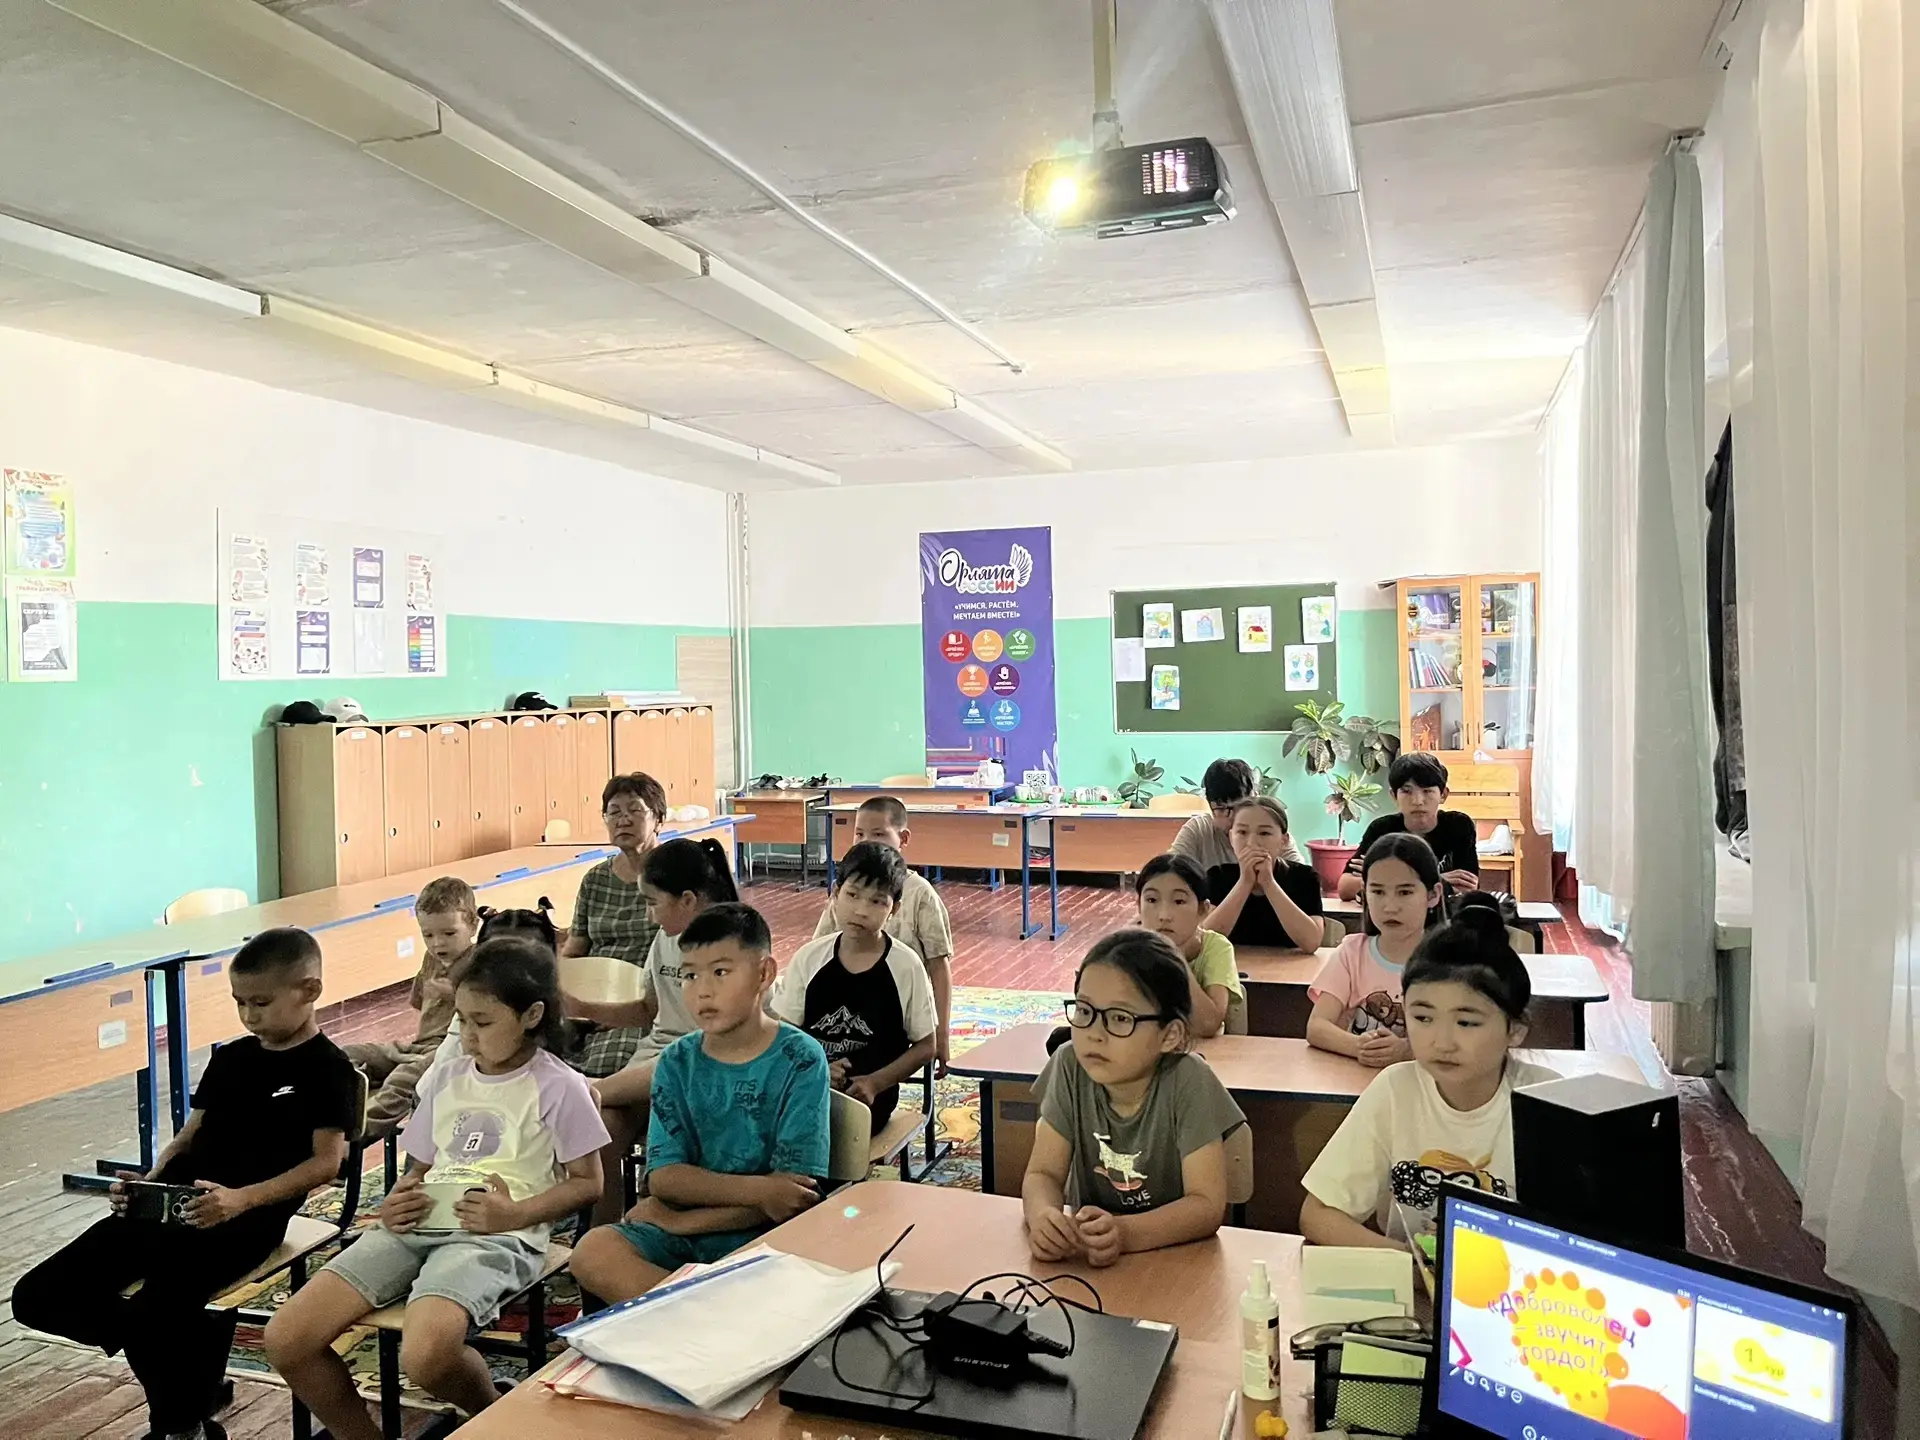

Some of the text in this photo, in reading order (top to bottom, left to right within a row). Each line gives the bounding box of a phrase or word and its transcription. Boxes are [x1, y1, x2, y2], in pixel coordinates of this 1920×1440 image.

[941, 550, 1015, 587] Орлята
[953, 612, 986, 620] МЕЧТАЕМ
[1120, 1189, 1151, 1205] LOVE
[1487, 1291, 1636, 1348] «Доброволец
[1536, 1324, 1607, 1353] звучит
[1520, 1345, 1610, 1378] гордо!»
[1744, 1347, 1754, 1363] 1
